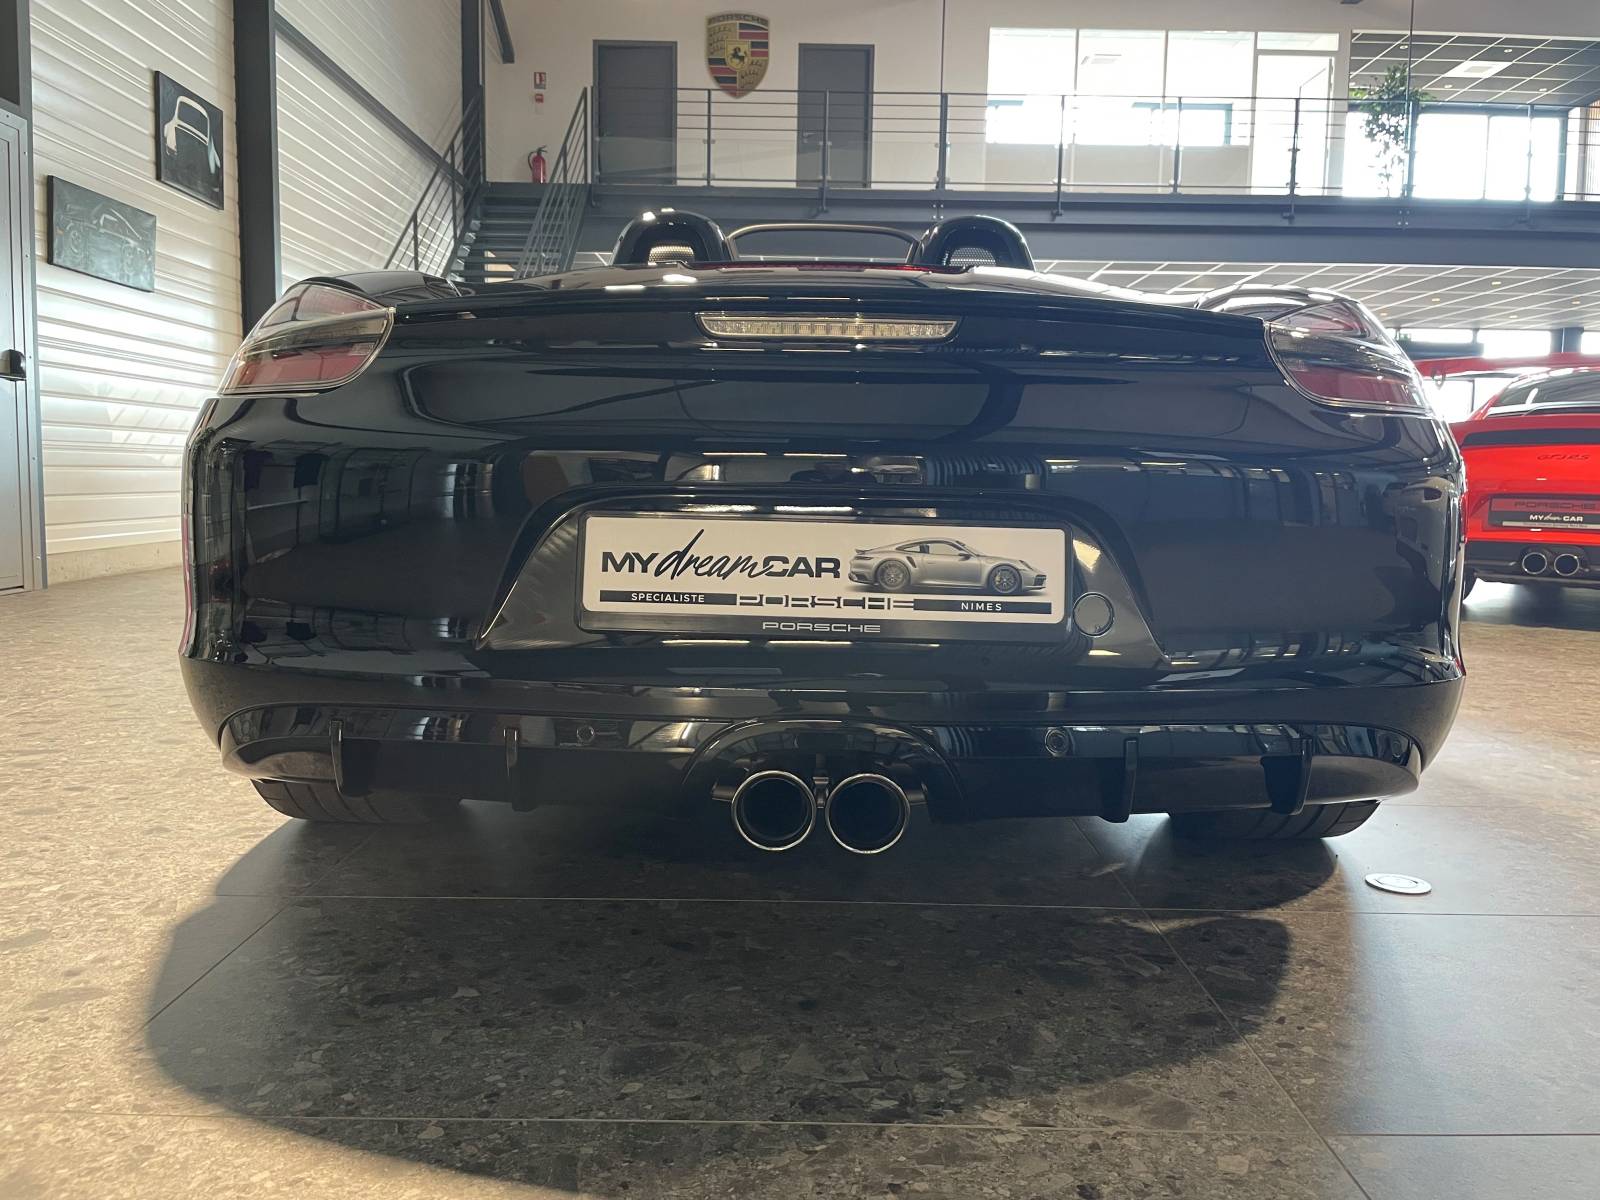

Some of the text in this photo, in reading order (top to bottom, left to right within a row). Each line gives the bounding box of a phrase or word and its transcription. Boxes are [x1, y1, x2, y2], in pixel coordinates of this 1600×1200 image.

[601, 528, 841, 580] MY dream CAR
[631, 592, 706, 603] SPECIALISTE
[961, 601, 1003, 612] NIMES
[762, 621, 881, 633] PORSCHE
